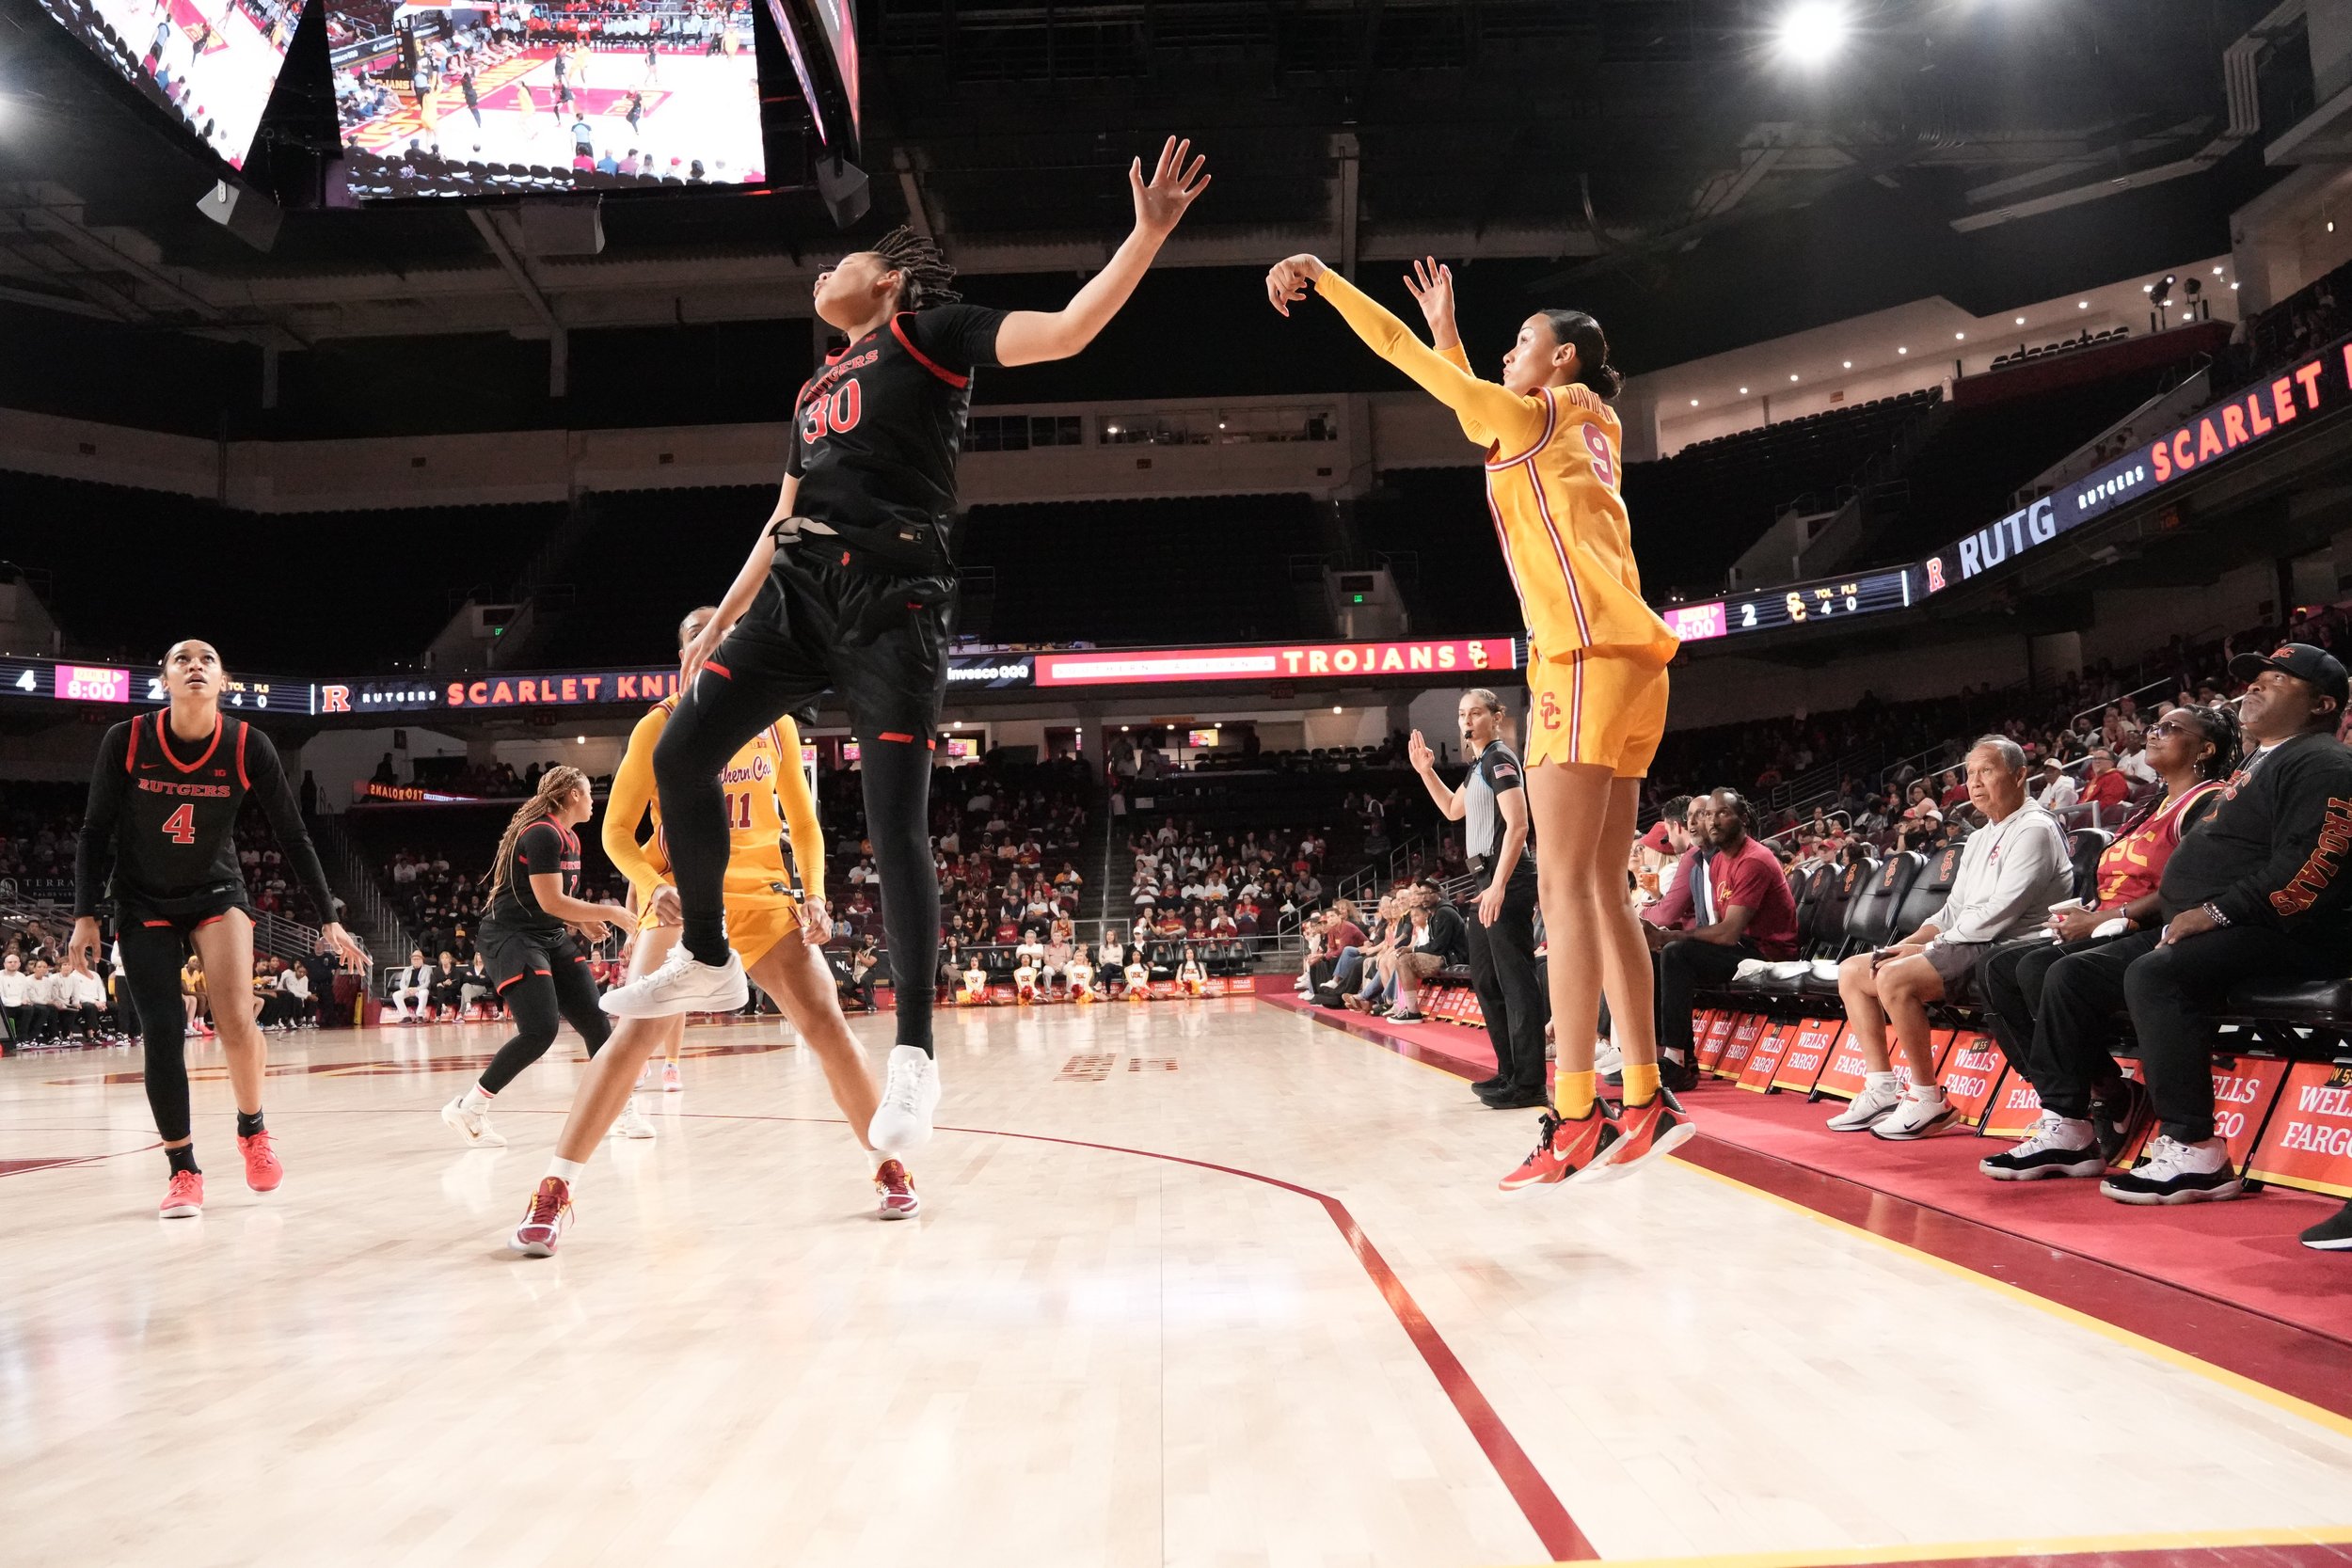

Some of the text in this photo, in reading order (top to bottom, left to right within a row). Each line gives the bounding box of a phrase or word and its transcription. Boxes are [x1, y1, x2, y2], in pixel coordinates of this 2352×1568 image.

[803, 378, 861, 444] 30
[2152, 360, 2322, 482] SCARLET
[1581, 421, 1615, 489] 9
[2078, 466, 2145, 509] RUTGERS
[1927, 496, 2057, 593] R RUTG
[1815, 583, 1857, 599] TOL FLS
[1787, 593, 1807, 623] SC
[1820, 596, 1857, 615] 4 0
[1675, 604, 1757, 640] 8:00 2
[1282, 645, 1456, 673] TROJANS
[1468, 641, 1488, 669] SC
[15, 670, 37, 692] 4
[999, 664, 1028, 679] QQQ
[68, 680, 116, 700] 8:00
[147, 678, 165, 700] 2
[229, 681, 269, 693] TOL FLS
[322, 674, 678, 712] R RUTGERS SCARLET KNI
[231, 693, 267, 708] 4 0
[1539, 691, 1562, 730] SC
[137, 778, 231, 798] RUTGERS
[724, 792, 752, 830] 11
[162, 802, 196, 844] 4
[1940, 849, 1956, 881] SC
[2268, 797, 2352, 916] TROJANS
[24, 879, 75, 888] TERRA
[1883, 857, 1899, 887] SC
[1711, 1021, 1732, 1036] WELLS
[1734, 1025, 1757, 1041] WELLS
[1703, 1038, 1724, 1053] FARGO
[1725, 1044, 1749, 1060] FARGO
[1759, 1037, 1785, 1053] WELLS
[1797, 1031, 1829, 1050] WELLS
[1750, 1056, 1775, 1073] FARGO
[1787, 1052, 1819, 1071] FARGO
[1954, 1048, 1998, 1072] WELLS
[1944, 1073, 1986, 1099] FARGO
[2212, 1075, 2261, 1104] ELLS
